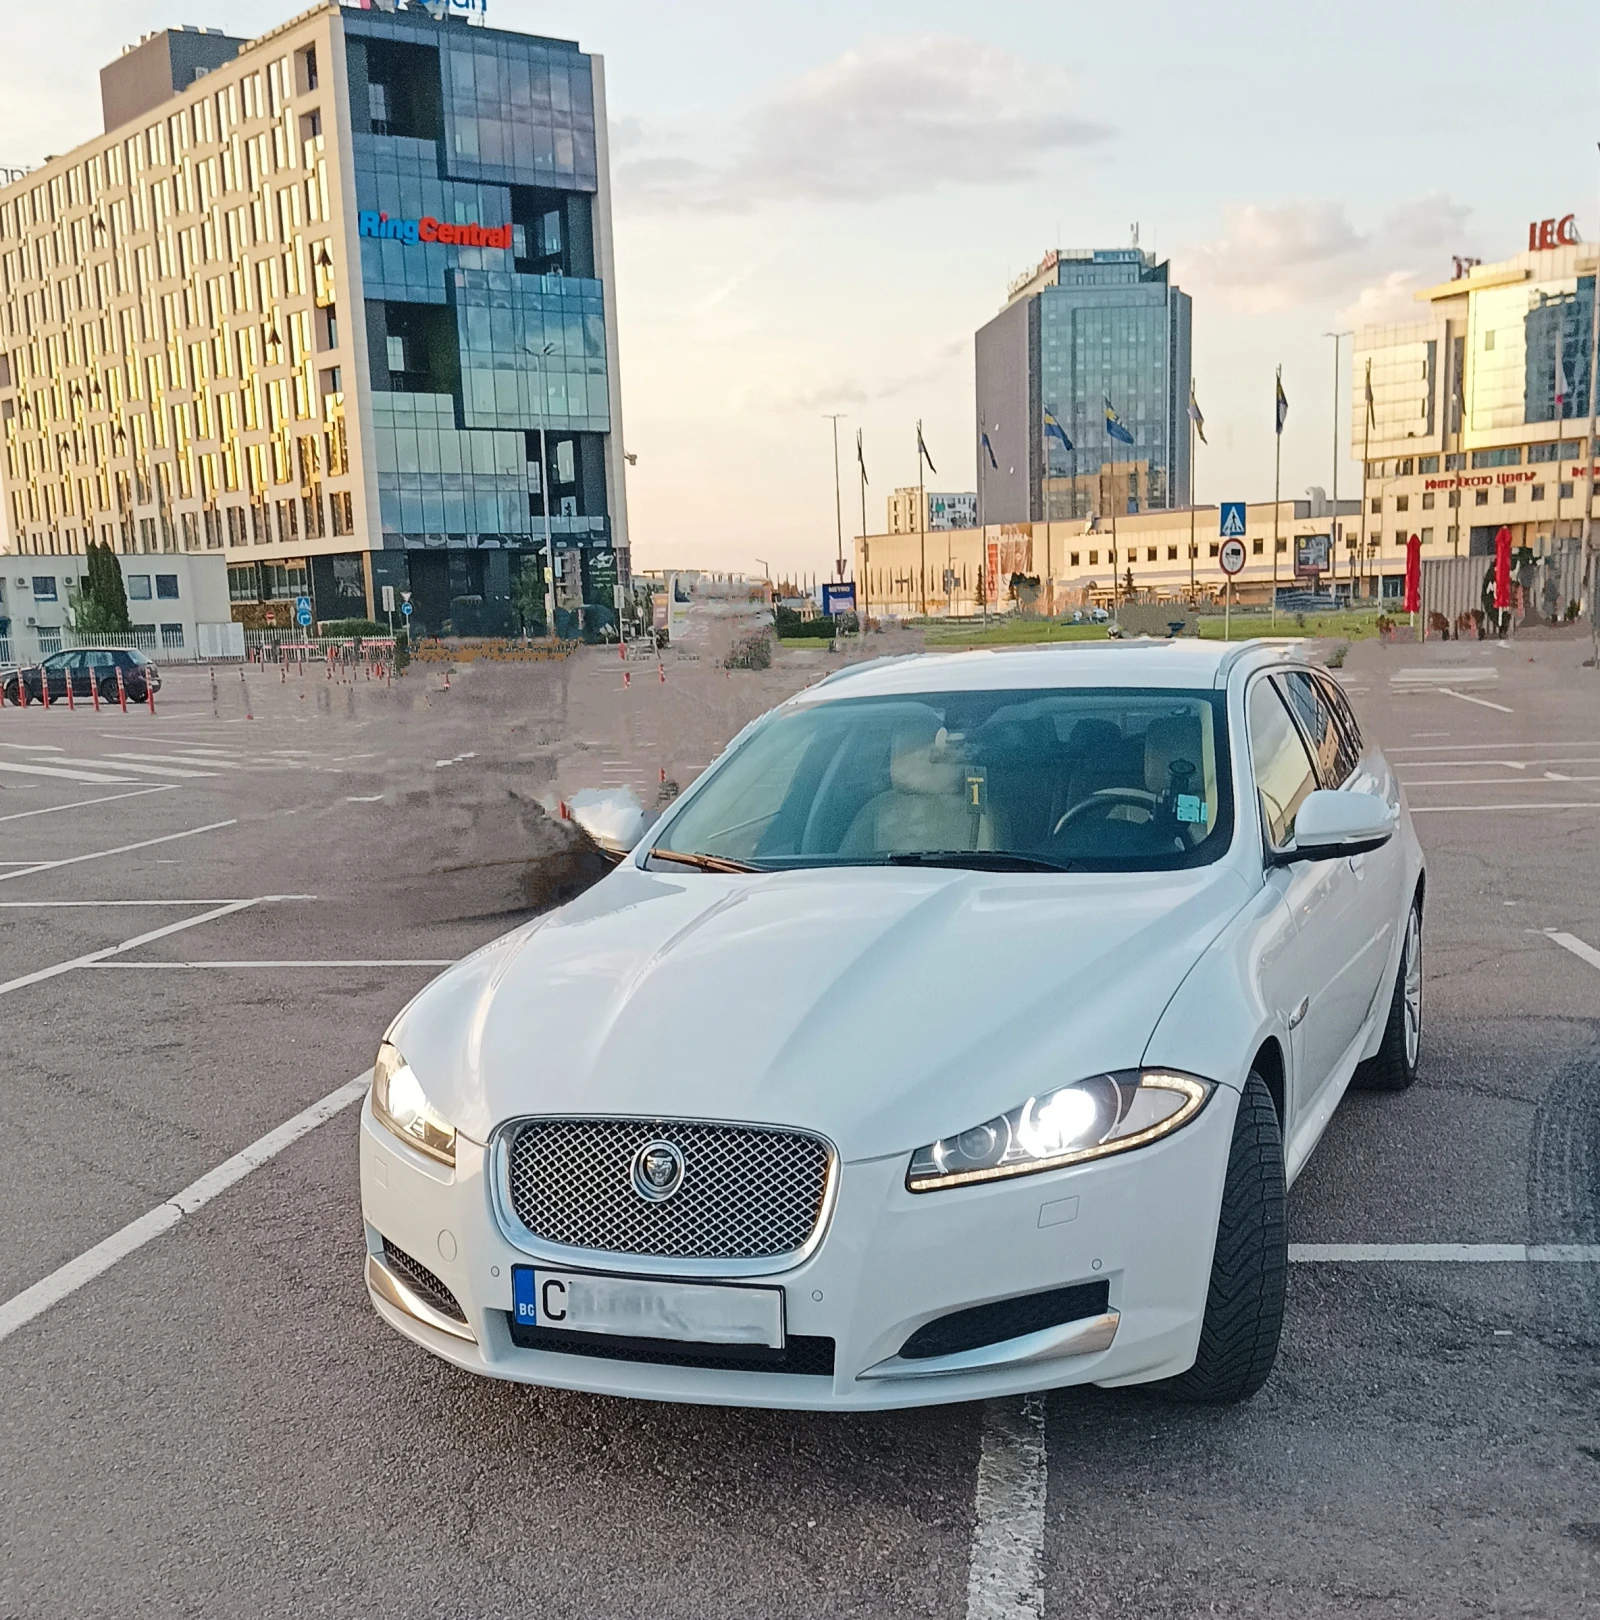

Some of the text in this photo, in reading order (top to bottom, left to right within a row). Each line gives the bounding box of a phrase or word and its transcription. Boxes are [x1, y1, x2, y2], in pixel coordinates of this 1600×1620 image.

[359, 210, 513, 249] RingCentral
[1529, 213, 1576, 251] IEC
[519, 1302, 535, 1317] BG
